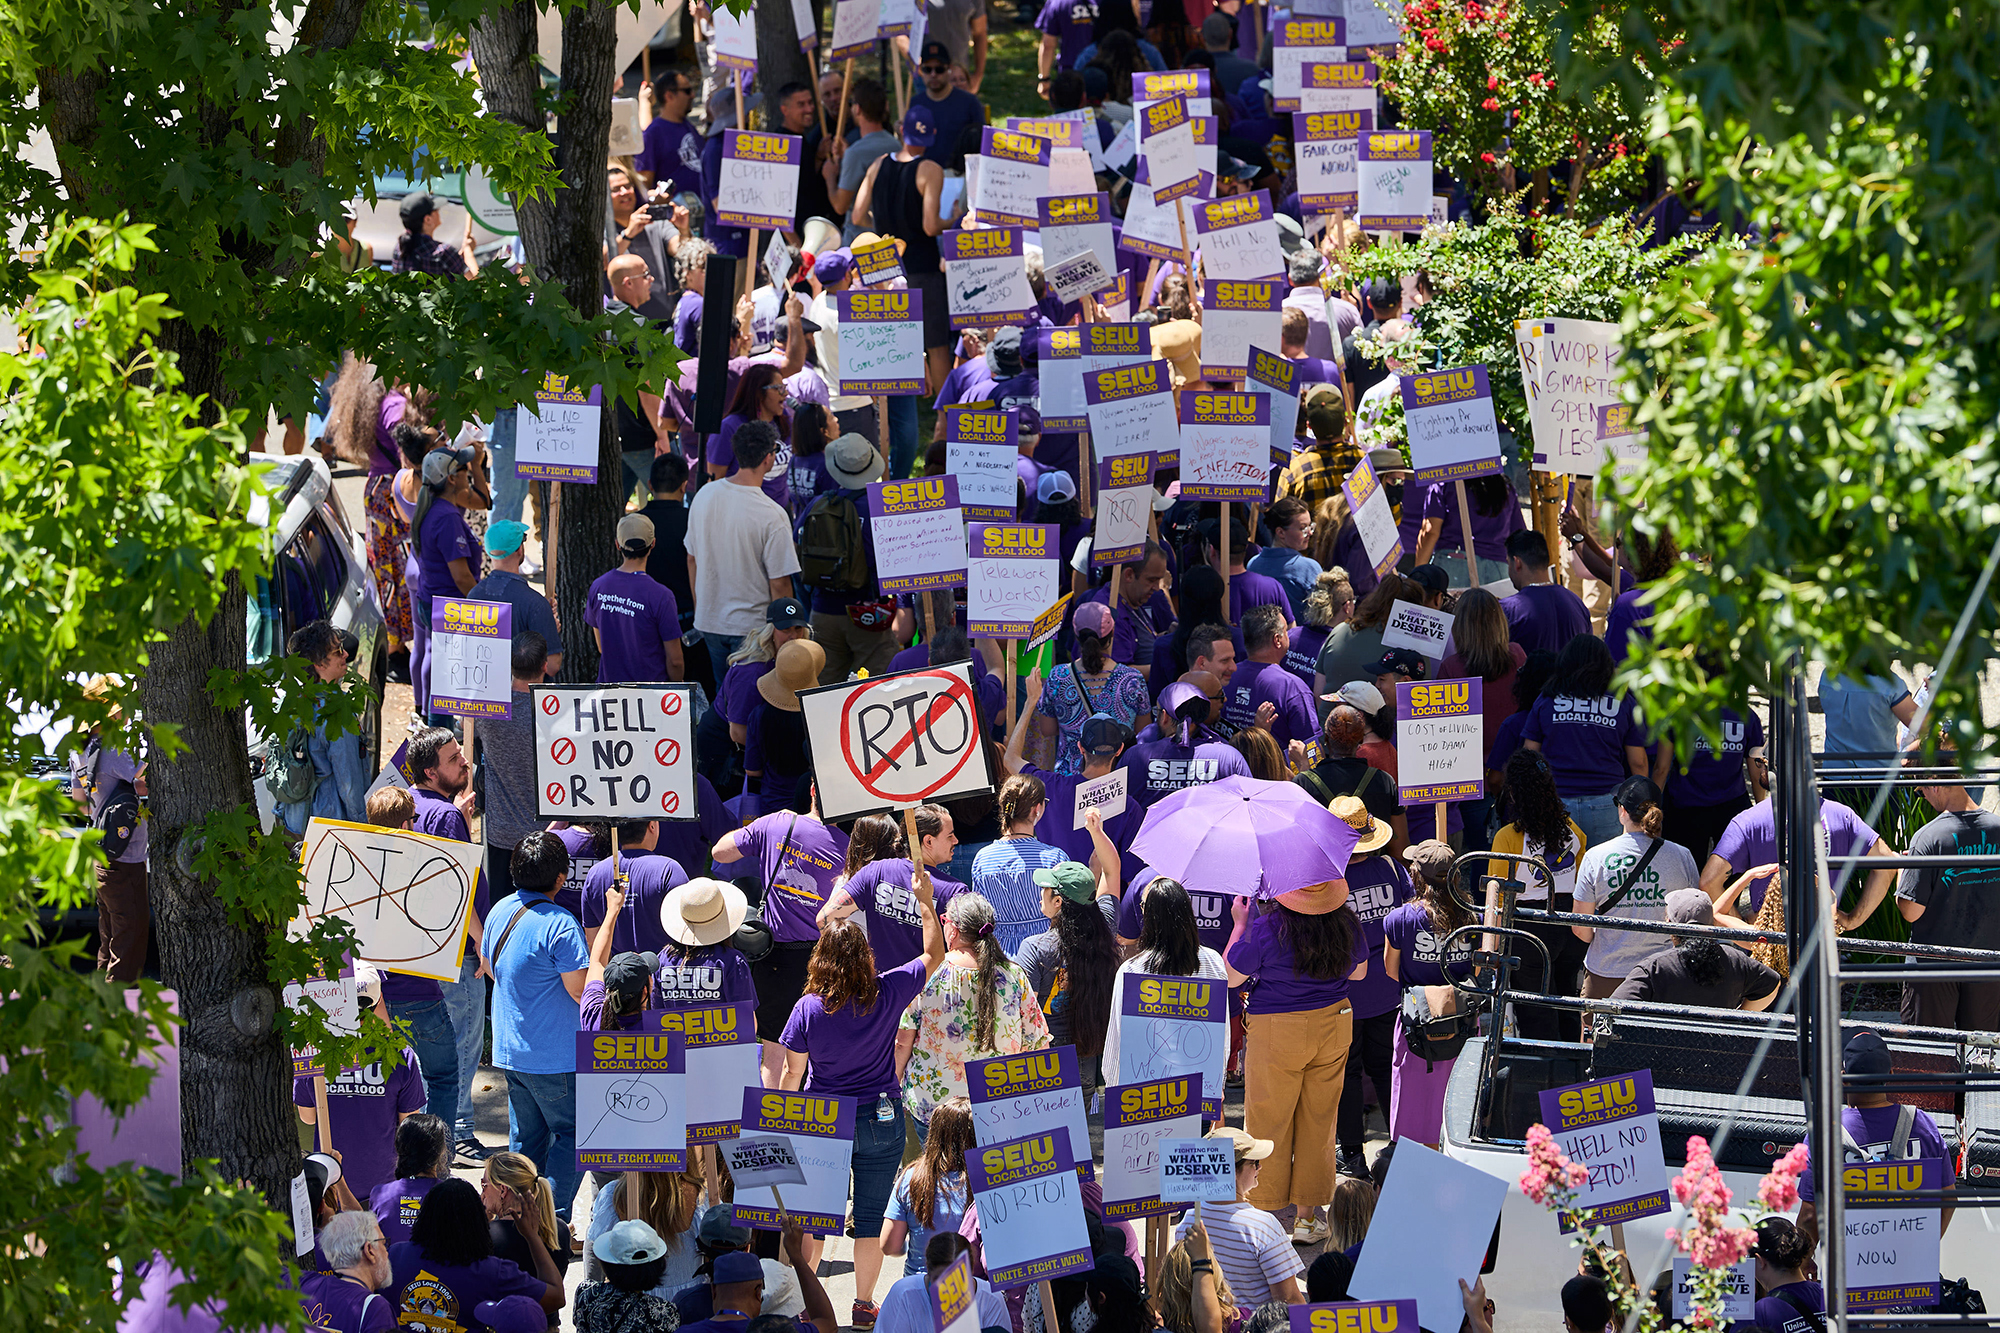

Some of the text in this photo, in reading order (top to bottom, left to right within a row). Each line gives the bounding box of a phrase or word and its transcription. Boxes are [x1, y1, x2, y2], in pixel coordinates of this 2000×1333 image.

[1144, 73, 1198, 92] SEIU
[1148, 98, 1182, 125] SEIU
[1306, 113, 1361, 132] SEIU
[736, 134, 789, 154] SEIU
[992, 132, 1042, 154] SEIU
[1369, 134, 1420, 151] SEIU
[734, 151, 788, 163] LOCAL 1000
[991, 148, 1039, 162] LOCAL 1000
[1369, 150, 1420, 159] LOCAL 1000
[1375, 166, 1411, 190] HELL NO
[1049, 197, 1099, 216] SEIU
[1205, 195, 1260, 221] SEIU
[1049, 214, 1099, 224] LOCAL 1000
[956, 230, 1011, 249] SEIU
[1212, 231, 1267, 249] Hell No
[1214, 257, 1230, 271] to
[1216, 282, 1271, 301] SEIU
[851, 294, 909, 311] SEIU
[1090, 326, 1139, 344] SEIU
[877, 356, 887, 364] on
[1256, 353, 1293, 382] SEIU
[1097, 365, 1156, 392] SEIU
[1414, 371, 1475, 396] SEIU
[1195, 396, 1256, 414] SEIU
[1417, 389, 1477, 405] LOCAL 1000
[563, 410, 580, 423] NO
[537, 438, 574, 453] RTO!
[518, 465, 593, 477] UNITE. FIGHT. WIN.
[1111, 456, 1149, 478] SEIU
[1193, 460, 1268, 482] INFLATION
[1418, 460, 1499, 480] UNITE. FIGHT. WIN.
[882, 481, 945, 504] SEIU
[1183, 487, 1265, 496] UNITE. FIGHT. WIN.
[1109, 499, 1136, 526] RTO
[874, 518, 893, 531] RTO
[983, 528, 1046, 548] SEIU
[983, 547, 1045, 556] LOCAL 1000
[600, 602, 635, 617] Anywhere
[626, 599, 644, 610] from
[444, 603, 499, 626] SEIU
[444, 622, 498, 635] LOCAL 1000
[1391, 619, 1445, 640] DESERVE
[477, 643, 492, 659] no
[451, 664, 488, 689] RTO!
[1411, 683, 1469, 706] SEIU
[433, 699, 507, 714] UNITE. FIGHT. WIN.
[574, 698, 656, 732] HELL
[1412, 703, 1469, 716] LOCAL 1000
[1553, 693, 1620, 718] SEIU
[1408, 722, 1435, 736] COST
[1448, 723, 1478, 736] LIVING
[1552, 712, 1617, 728] LOCAL 1000
[858, 690, 969, 774] RTO
[592, 740, 633, 769] NO
[1419, 739, 1469, 753] TOO DAMN
[1148, 759, 1218, 782] SEIU
[1429, 755, 1458, 771] HIGH!
[571, 774, 651, 808] RTO
[1147, 779, 1184, 790] LOCAL
[1079, 787, 1123, 810] DESERVE
[792, 848, 832, 871] LOCAL 1000
[1605, 853, 1637, 870] Go
[322, 842, 464, 931] RTO
[1625, 884, 1666, 900] rock
[874, 903, 902, 923] LOCAL
[661, 967, 722, 990] SEIU
[662, 989, 720, 999] LOCAL 1000
[1139, 979, 1210, 1007] SEIU
[1138, 1004, 1209, 1018] LOCAL 1000
[593, 1037, 668, 1060] SEIU
[592, 1060, 668, 1070] LOCAL 1000
[984, 1054, 1060, 1086] SEIU
[355, 1085, 385, 1094] 1000
[987, 1076, 1062, 1098] LOCAL 1000
[611, 1092, 651, 1111] RTO
[1120, 1082, 1188, 1112] SEIU
[1558, 1078, 1636, 1117] SEIU
[760, 1094, 838, 1123] SEIU
[1121, 1104, 1187, 1123] LOCAL 1000
[1561, 1102, 1638, 1128] LOCAL 1000
[758, 1118, 837, 1134] LOCAL 1000
[1121, 1132, 1151, 1154] RTO
[1567, 1125, 1648, 1162] HELL NO
[580, 1152, 681, 1164] UNITE. FIGHT. WIN.
[731, 1155, 795, 1170] DESERVE
[982, 1136, 1055, 1173] SEIU
[1169, 1154, 1226, 1163] WHAT WE
[1165, 1164, 1231, 1175] DESERVE
[1843, 1164, 1923, 1191] SEIU
[980, 1176, 1068, 1229] NO RTO!
[736, 1209, 773, 1222] UNITE.
[811, 1217, 839, 1228] WIN.
[1857, 1250, 1897, 1266] NOW
[408, 1280, 453, 1300] SEIU Local 1000
[1867, 1285, 1934, 1302] FIGHT. WIN.
[1310, 1306, 1398, 1333] SEIU
